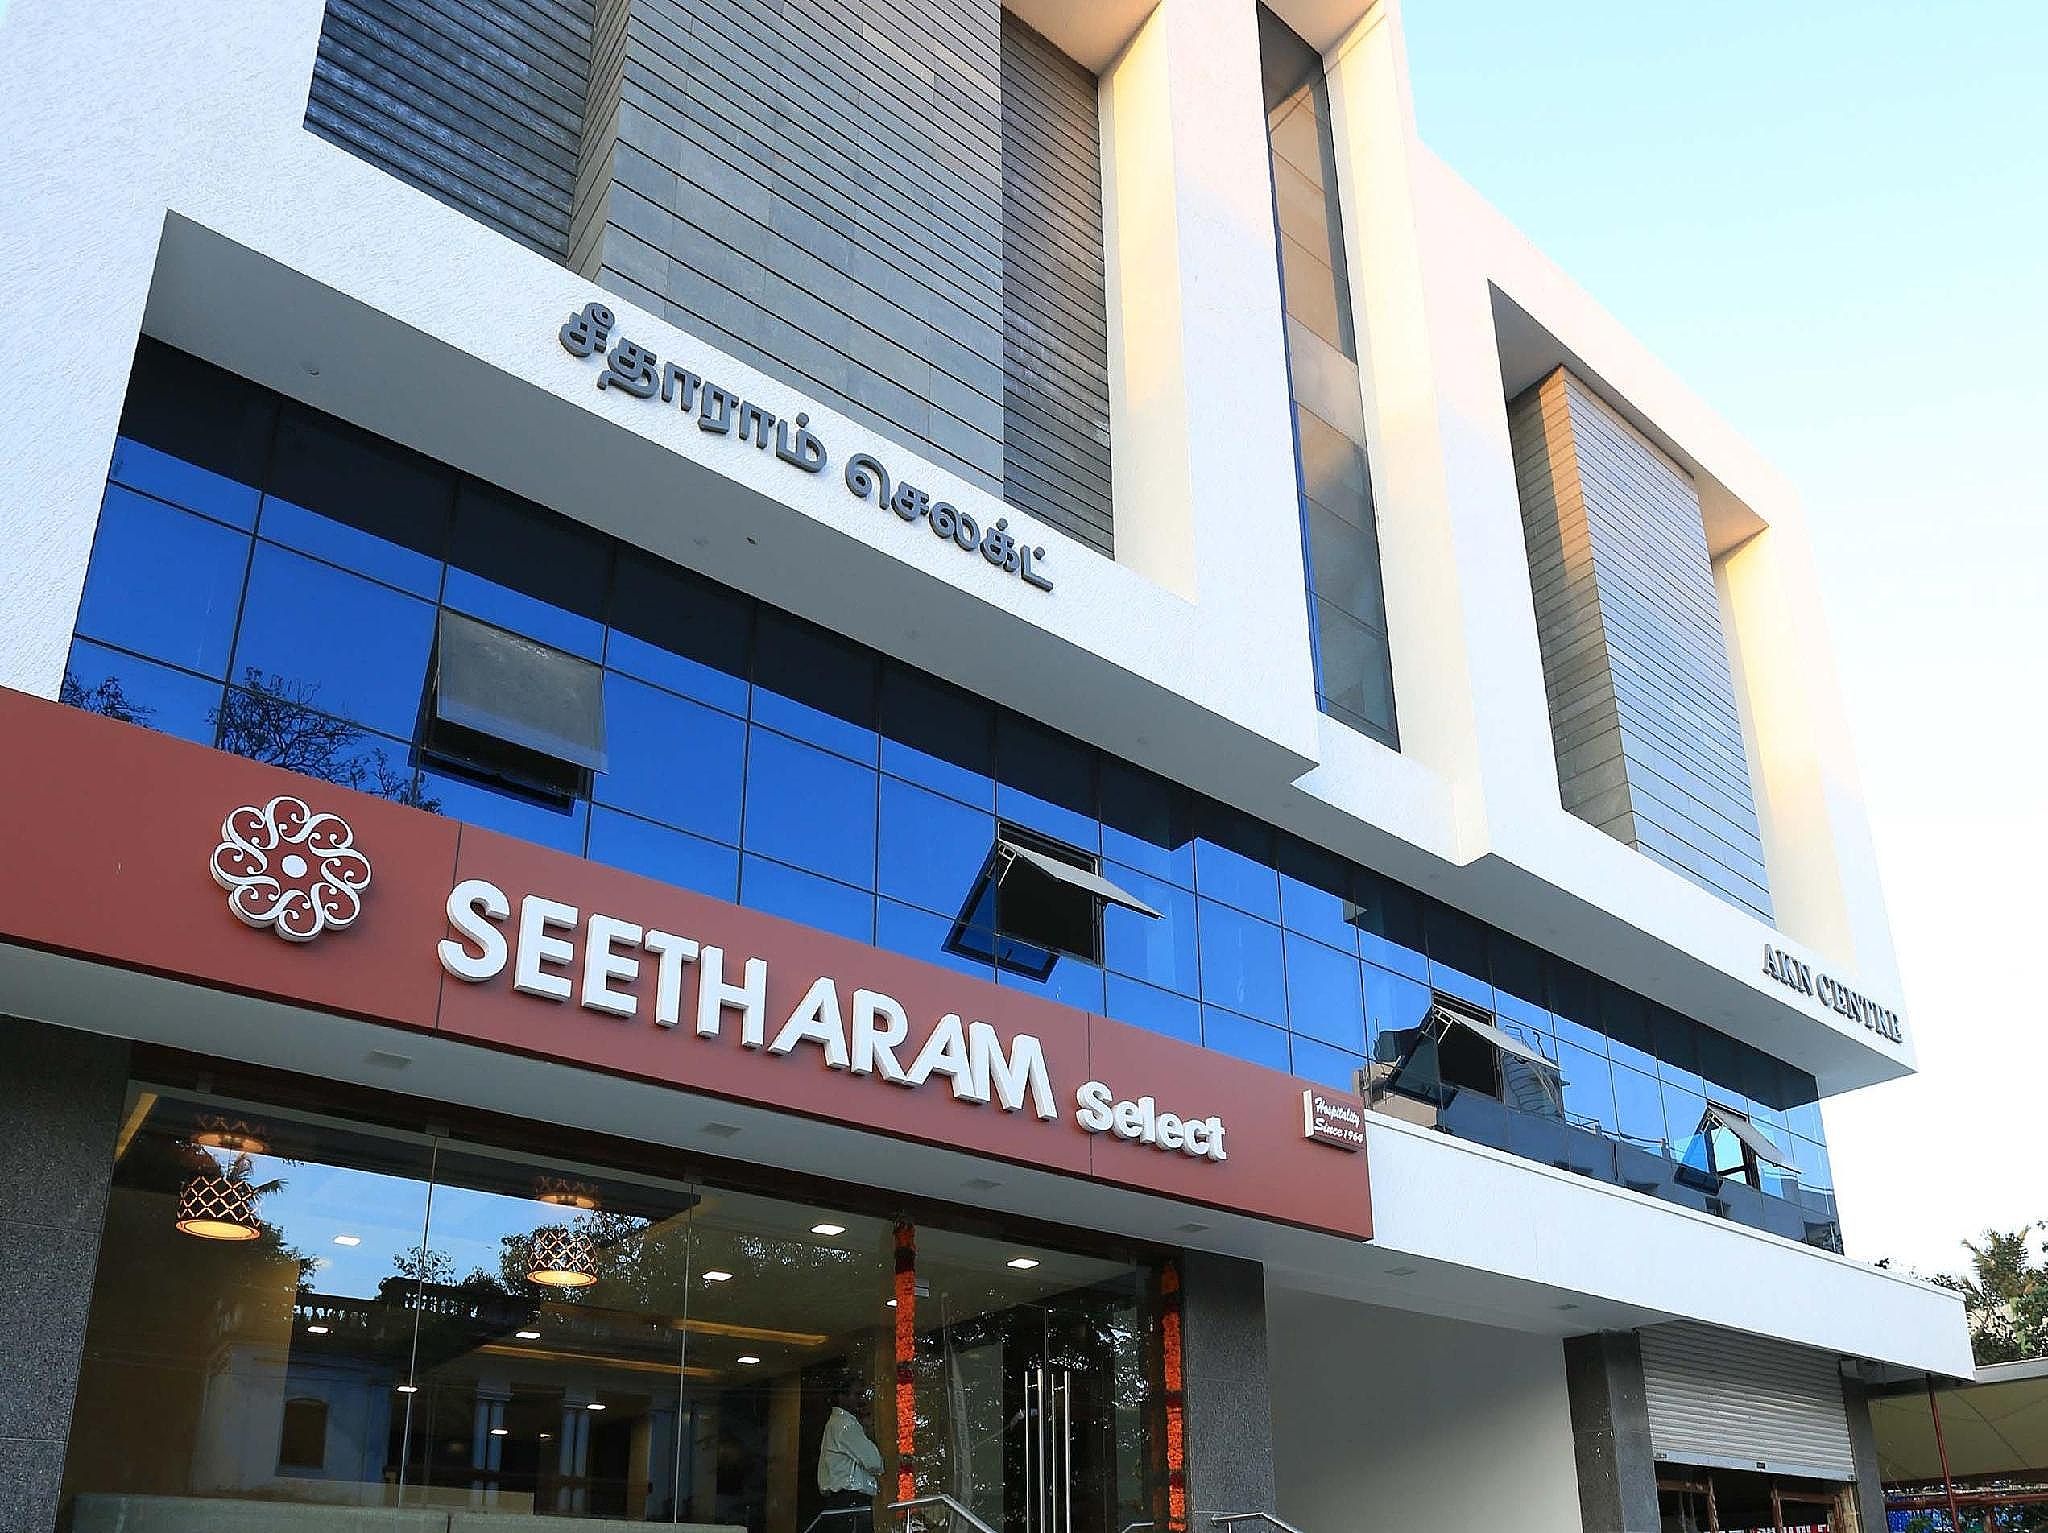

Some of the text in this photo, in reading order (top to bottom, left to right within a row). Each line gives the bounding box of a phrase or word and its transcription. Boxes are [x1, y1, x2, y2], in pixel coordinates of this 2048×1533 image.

[558, 302, 1054, 591] சீதாராம் செலக்ட்
[437, 878, 1228, 1162] SEETHARAM Select
[1762, 943, 1903, 1043] AKN CENTRE
